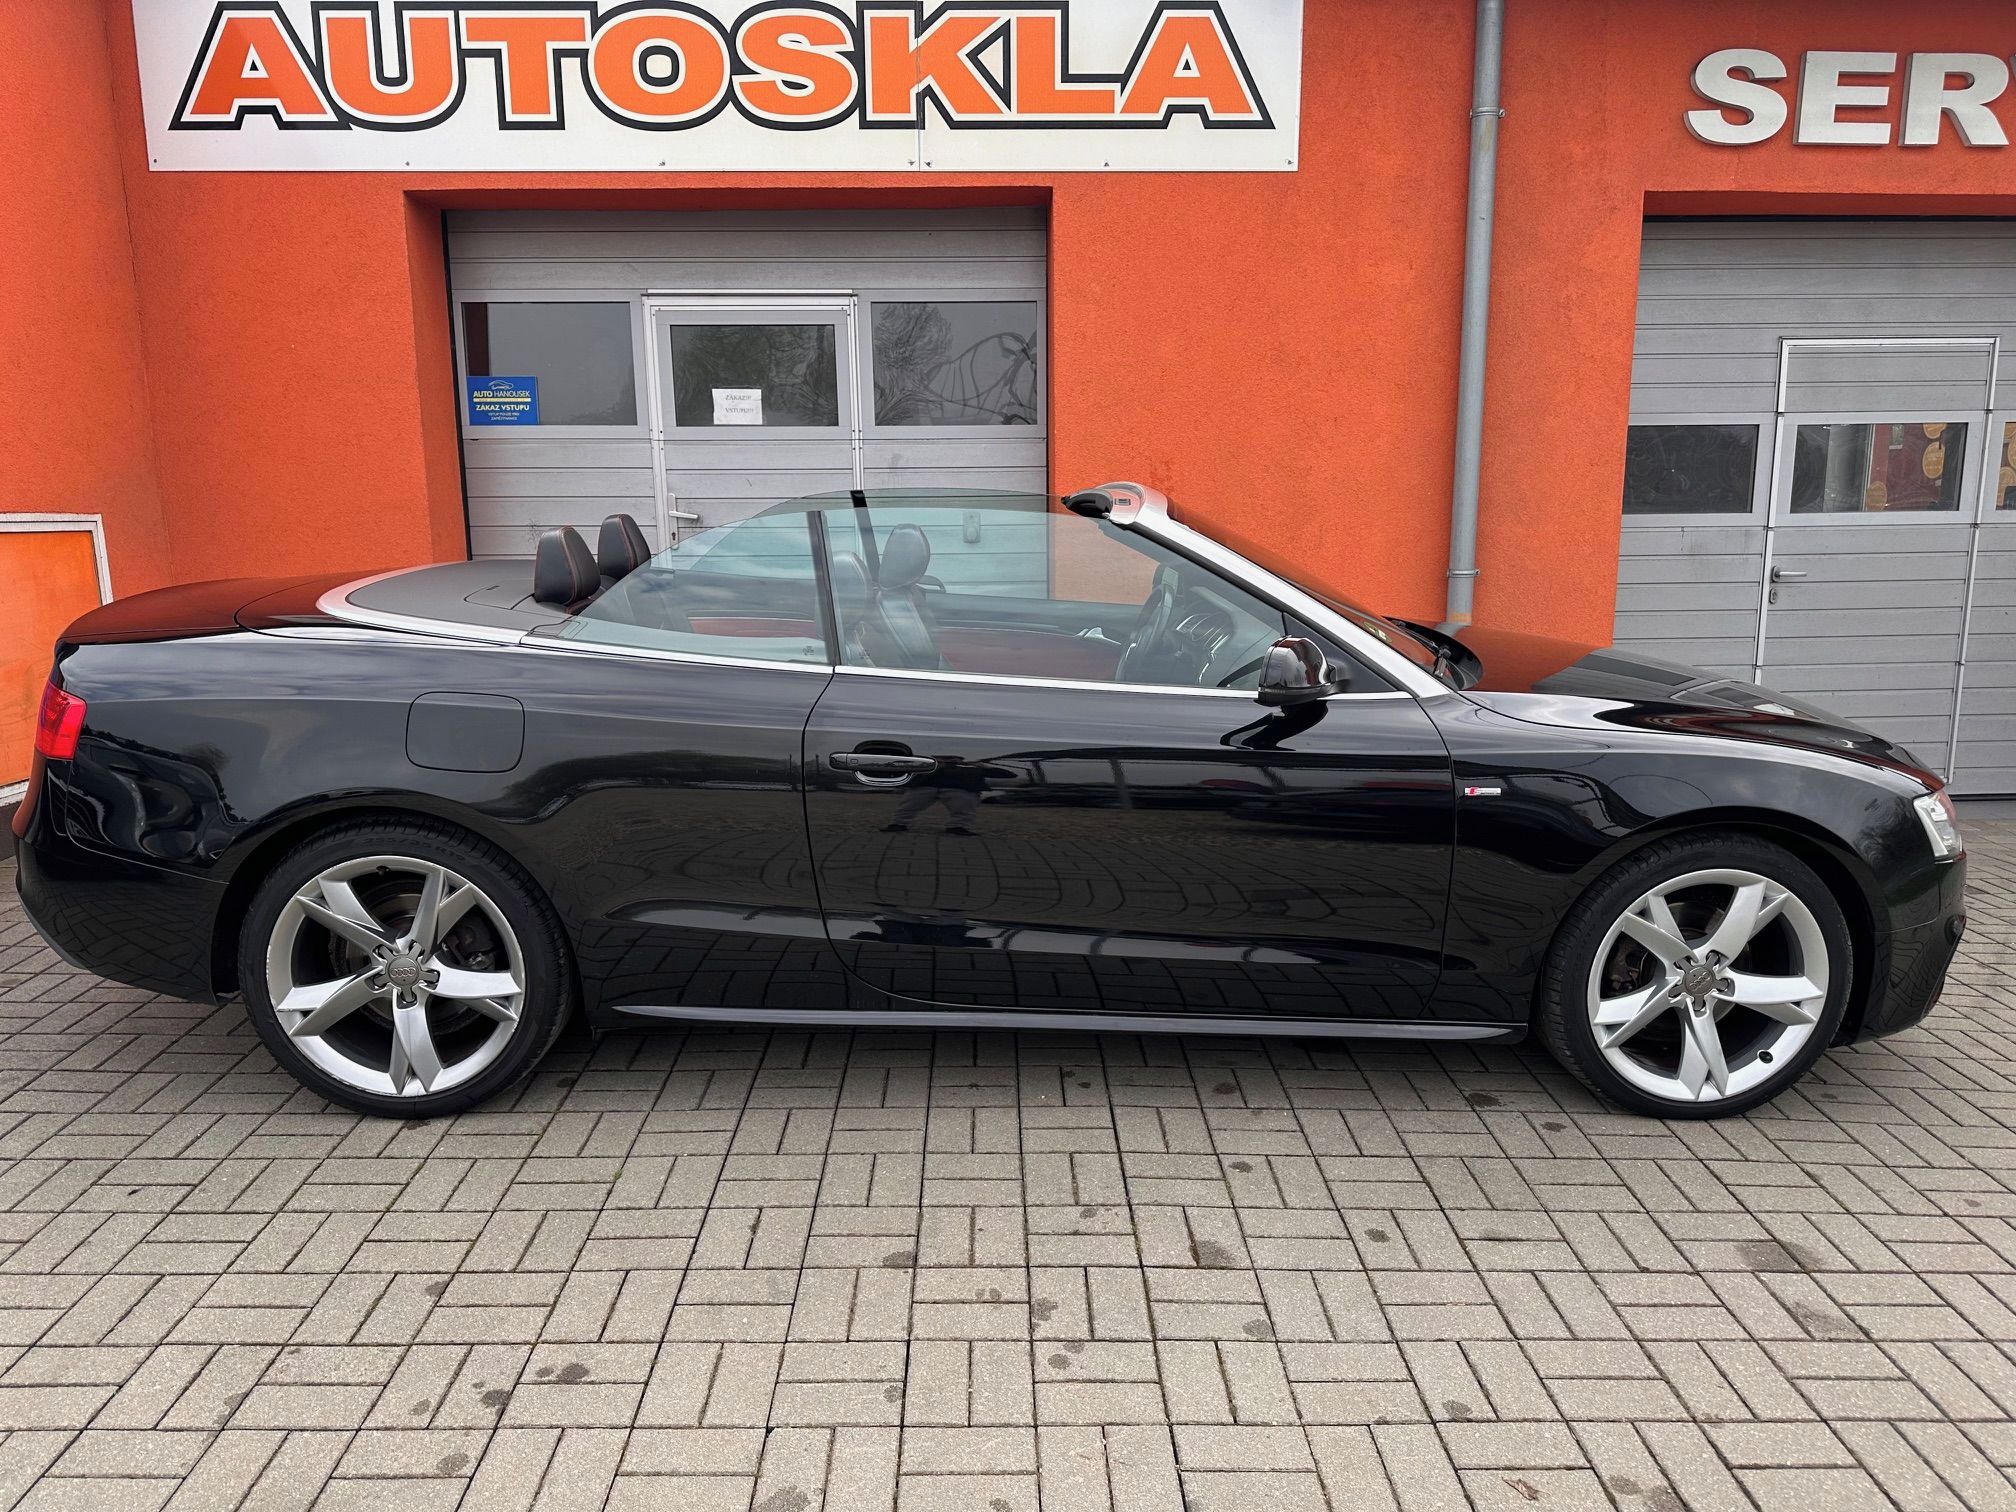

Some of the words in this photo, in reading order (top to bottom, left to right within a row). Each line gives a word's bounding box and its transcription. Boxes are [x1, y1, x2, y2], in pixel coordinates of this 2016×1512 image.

[169, 0, 1275, 131] AUTOSKLA
[1684, 48, 2016, 148] SER
[476, 403, 501, 411] ZÁKAZ
